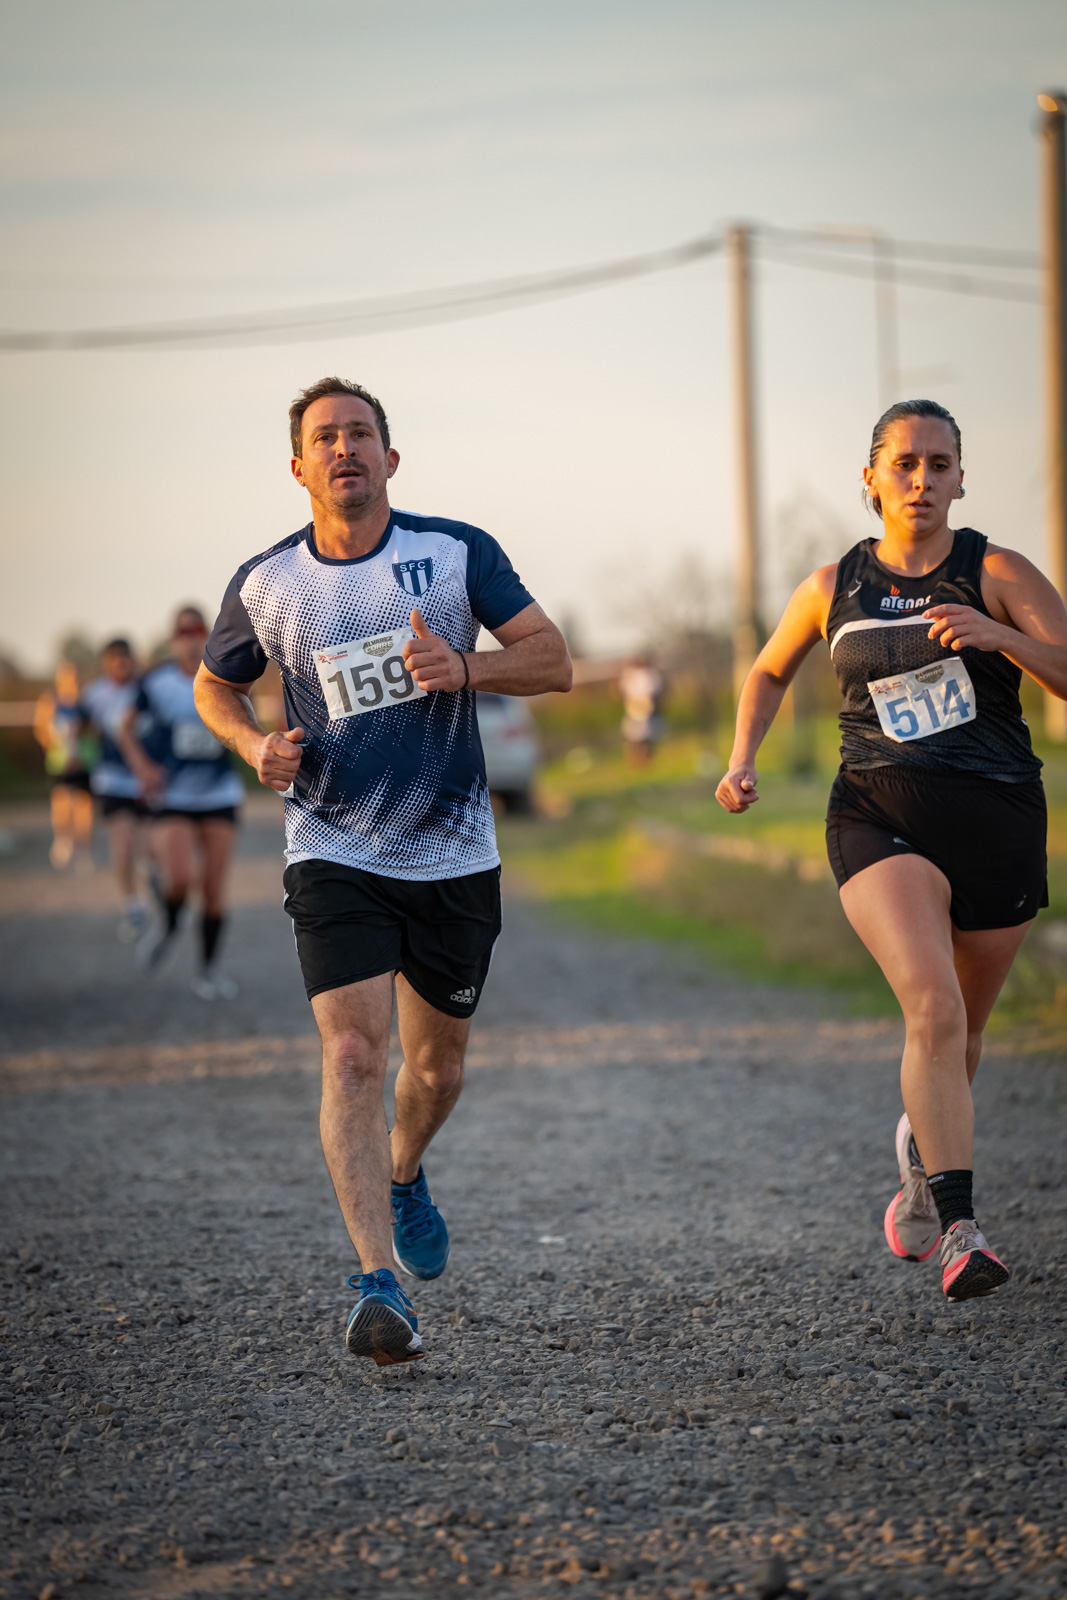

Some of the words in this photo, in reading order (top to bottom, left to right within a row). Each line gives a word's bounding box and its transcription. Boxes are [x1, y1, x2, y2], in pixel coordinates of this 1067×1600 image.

[400, 561, 426, 573] SFC
[880, 595, 931, 609] ATENAS
[363, 635, 393, 649] ALVAREZ
[365, 641, 394, 653] CORRE
[327, 655, 415, 714] 159
[886, 679, 971, 738] 514
